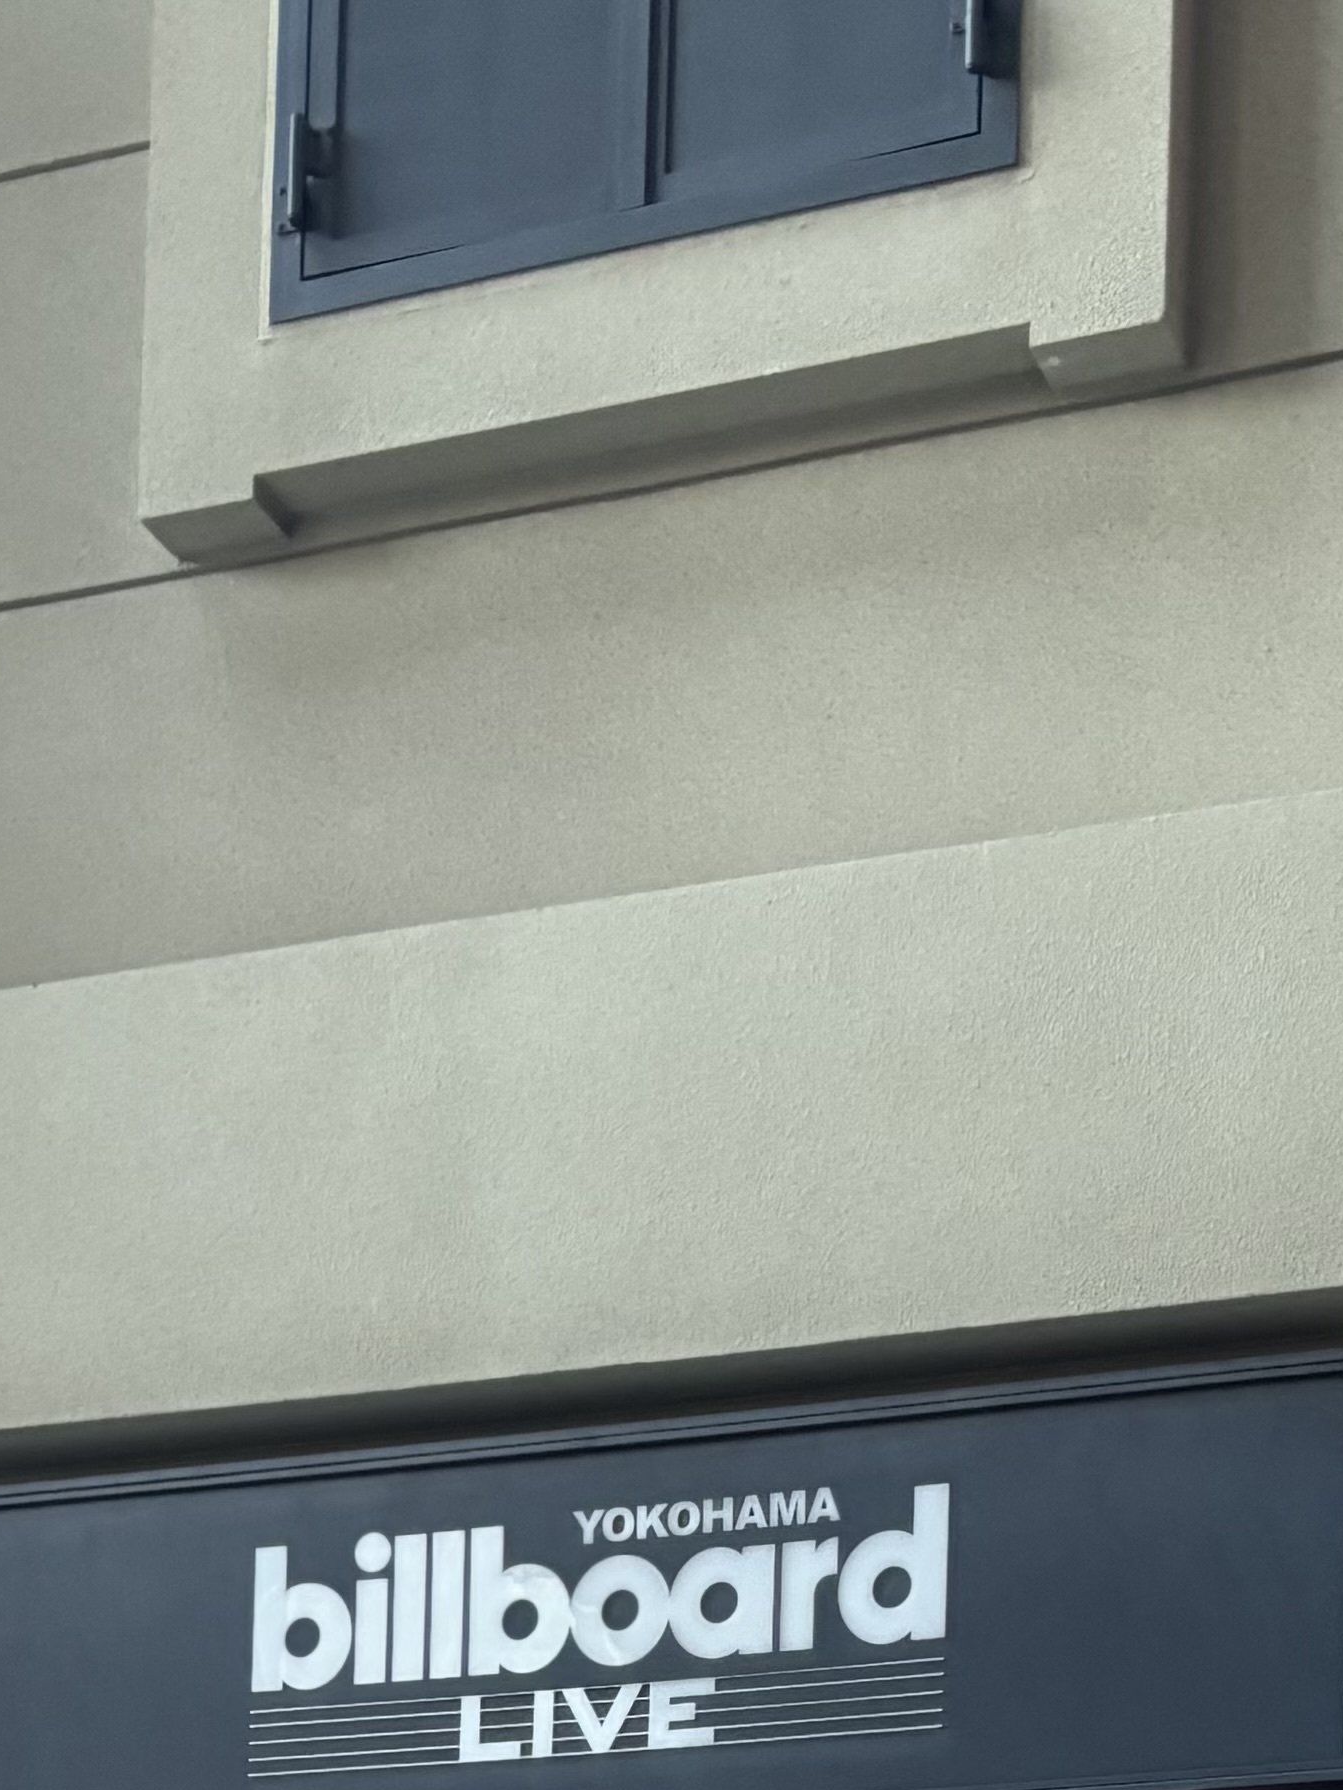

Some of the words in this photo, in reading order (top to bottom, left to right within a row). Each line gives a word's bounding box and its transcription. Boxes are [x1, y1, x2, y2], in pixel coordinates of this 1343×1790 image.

[572, 1485, 842, 1546] YOKOHAMA
[249, 1481, 952, 1694] billboard
[458, 1677, 719, 1764] LIVE
